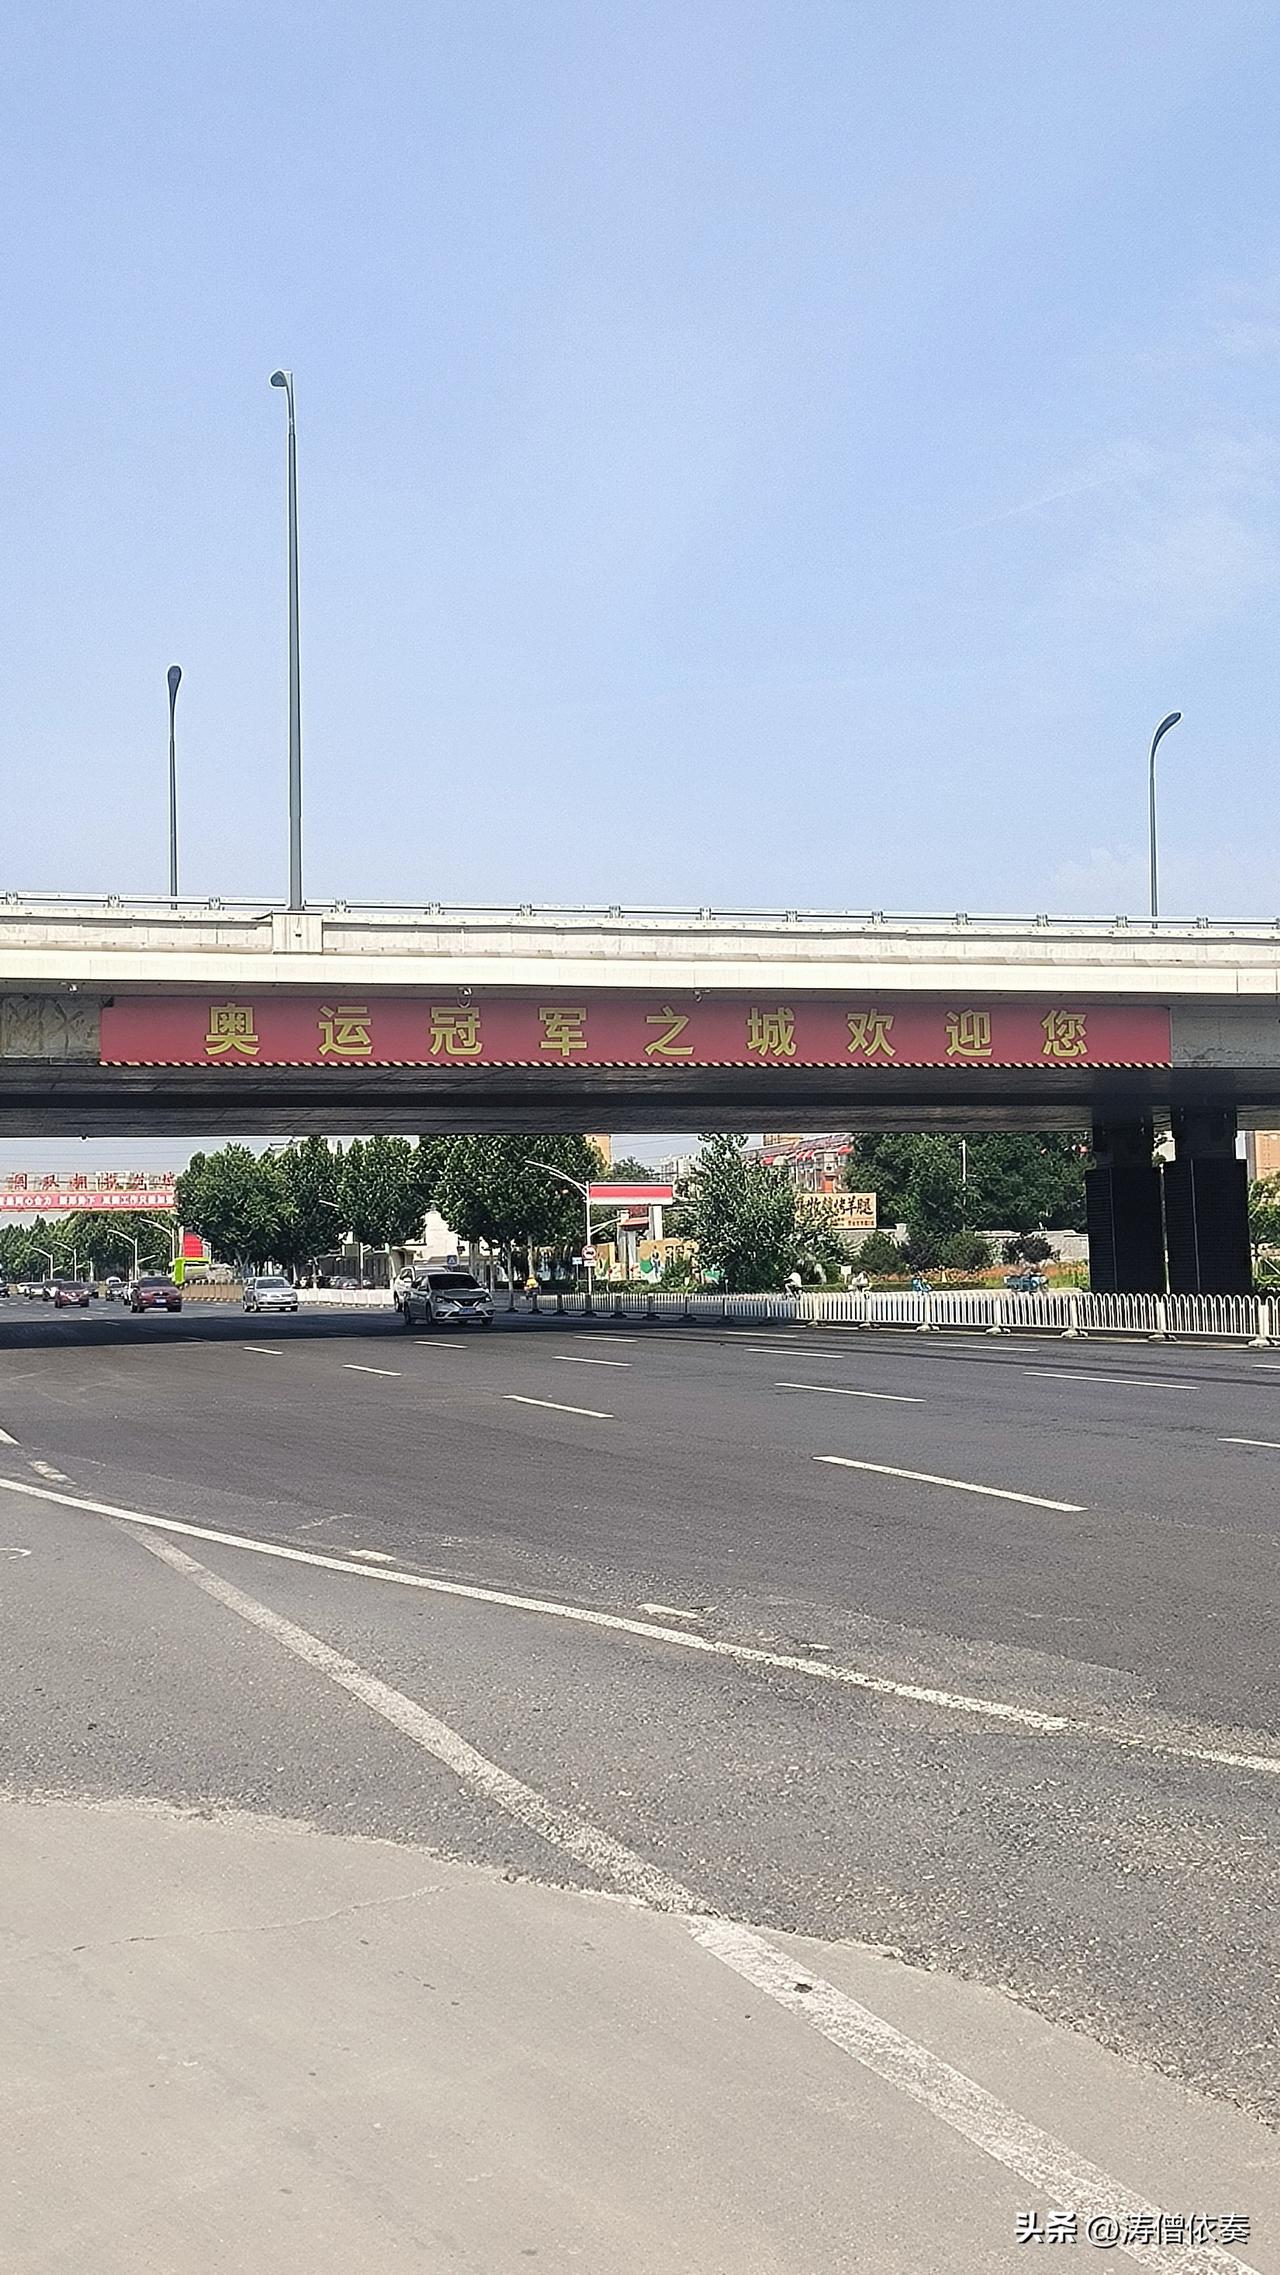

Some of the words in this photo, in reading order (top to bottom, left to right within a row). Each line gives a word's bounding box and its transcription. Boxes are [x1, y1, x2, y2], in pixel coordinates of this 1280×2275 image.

[205, 1002, 1089, 1057] 奥运冠军之城欢迎您
